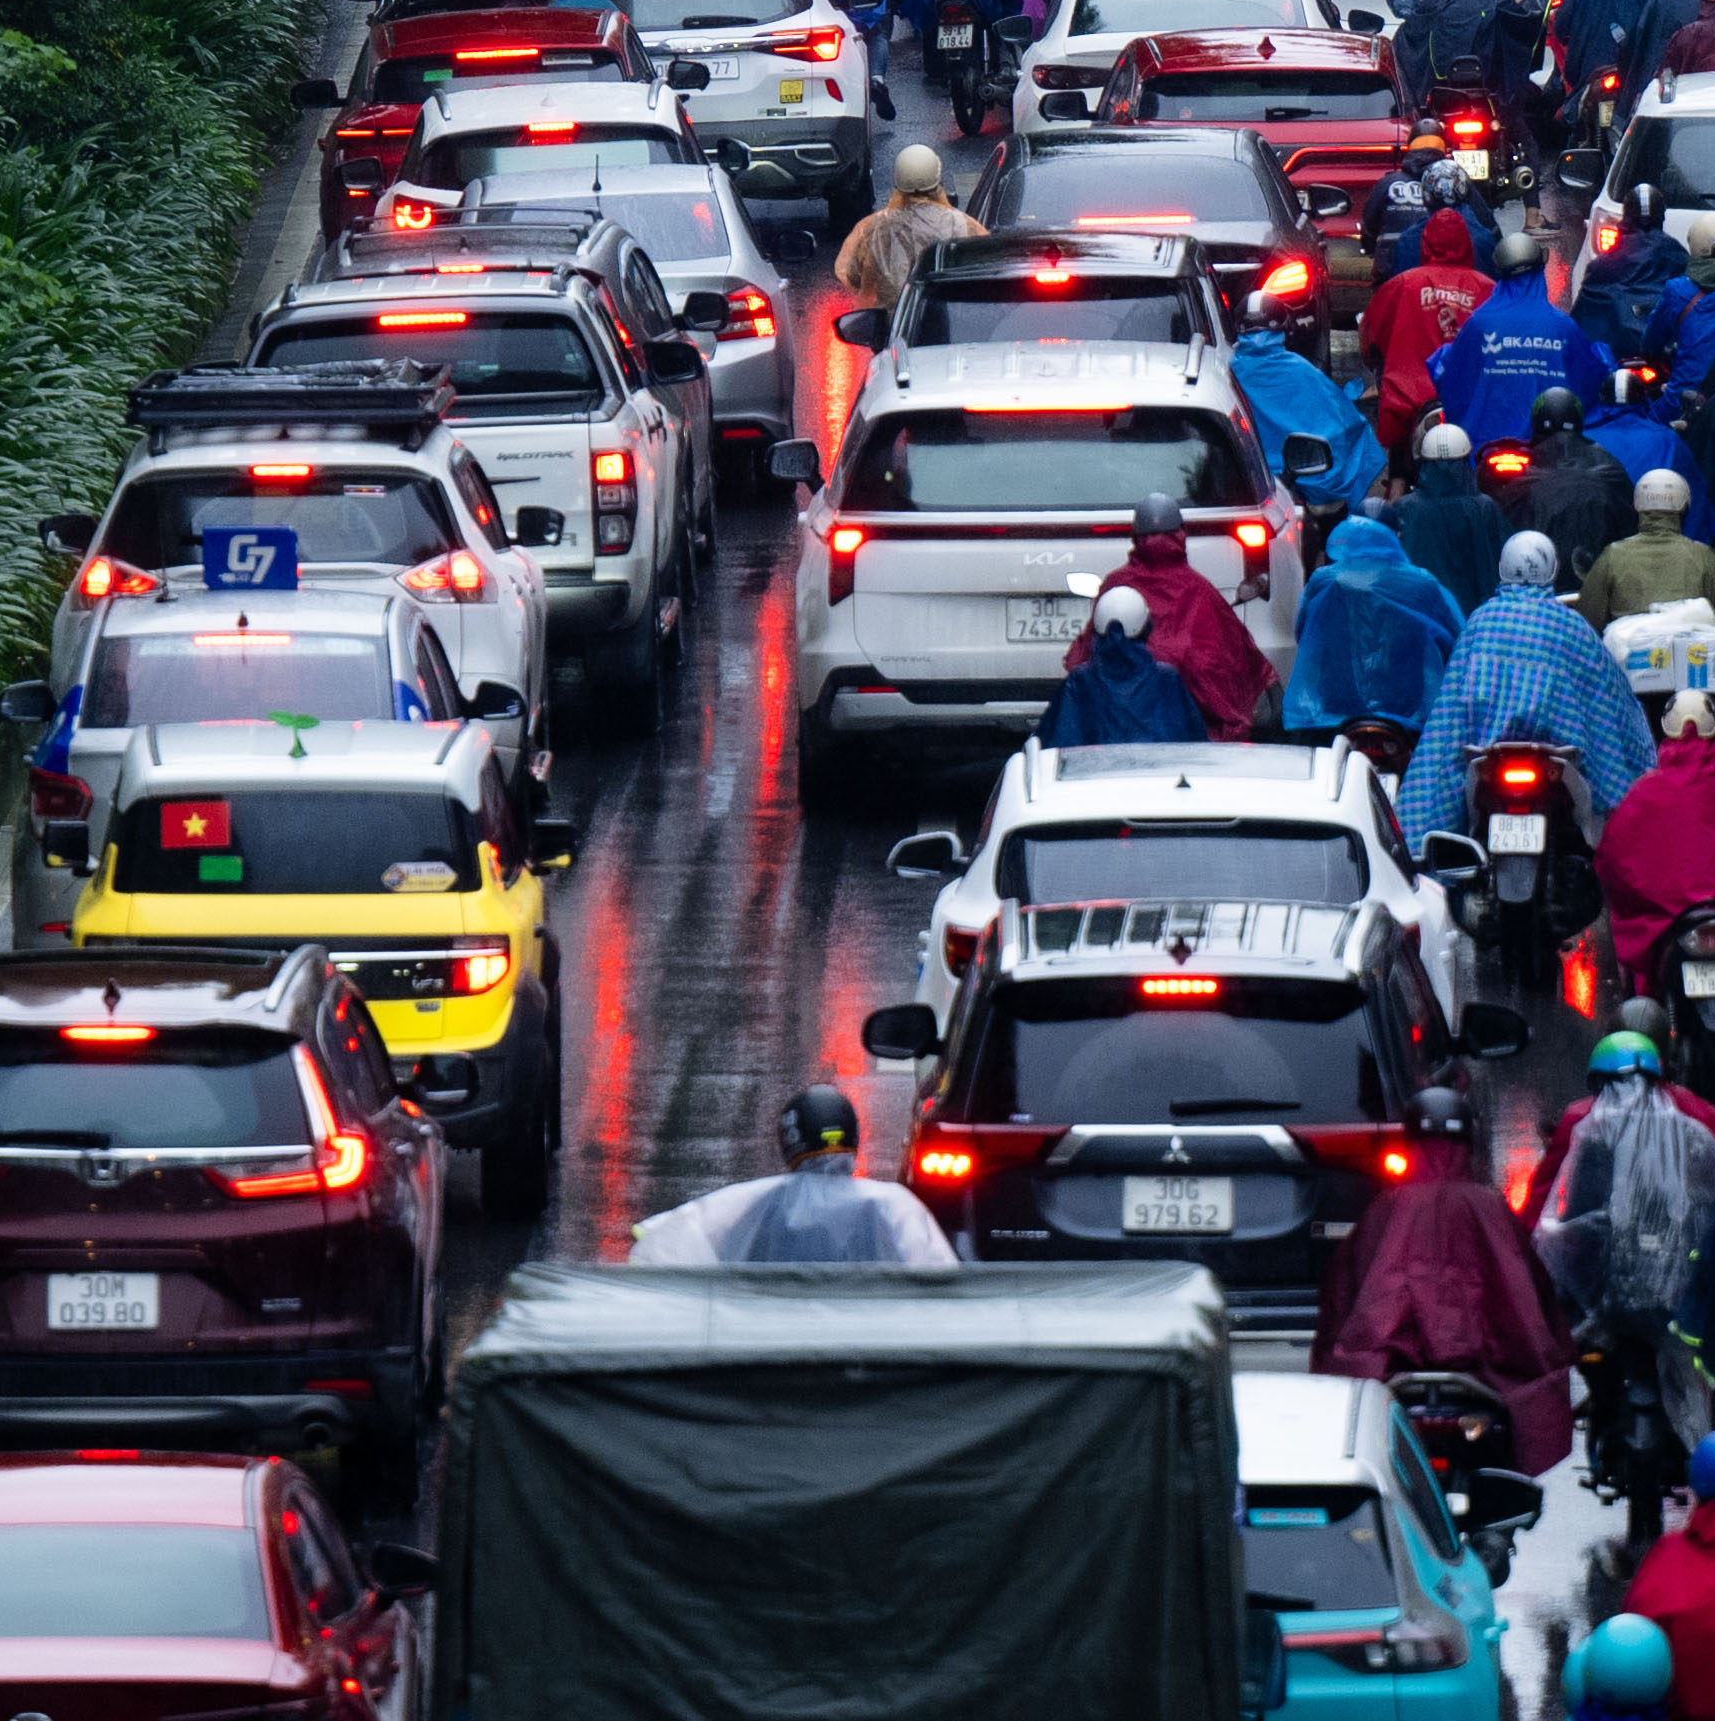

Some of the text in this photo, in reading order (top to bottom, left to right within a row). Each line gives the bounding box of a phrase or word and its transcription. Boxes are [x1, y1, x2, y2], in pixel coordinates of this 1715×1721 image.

[227, 534, 276, 584] G7
[1023, 552, 1075, 565] KIA
[1032, 599, 1068, 617] 30L
[1016, 619, 1083, 638] 743.45
[1153, 1178, 1200, 1201] 30G
[1134, 1204, 1219, 1226] 979.62
[80, 1275, 126, 1298] 30M
[59, 1301, 145, 1324] 039.80
